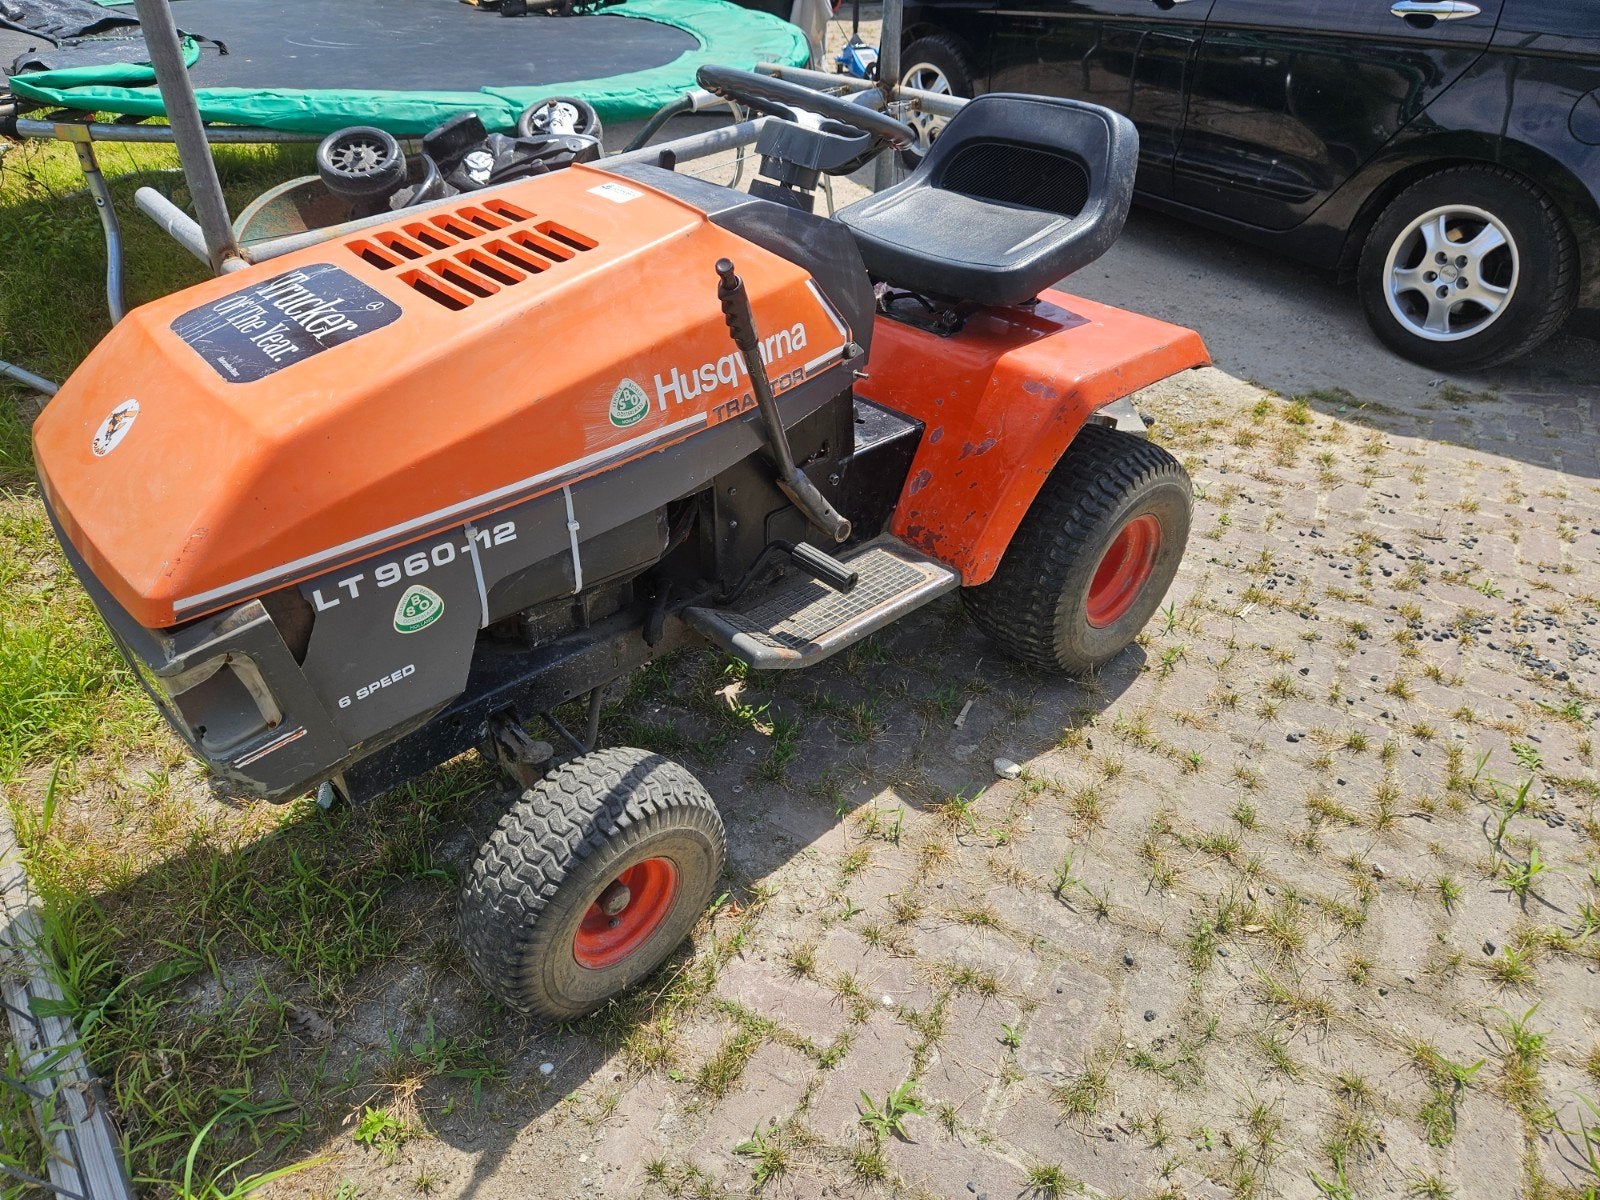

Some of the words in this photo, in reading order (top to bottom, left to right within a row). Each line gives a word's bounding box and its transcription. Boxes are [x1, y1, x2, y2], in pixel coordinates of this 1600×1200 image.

[255, 270, 358, 340] Trucker
[249, 322, 300, 363] Year.
[712, 367, 806, 423] TRATOR
[312, 574, 364, 612] LT
[374, 521, 517, 588] 960-12
[338, 696, 351, 708] 6
[356, 664, 416, 700] SPEED
